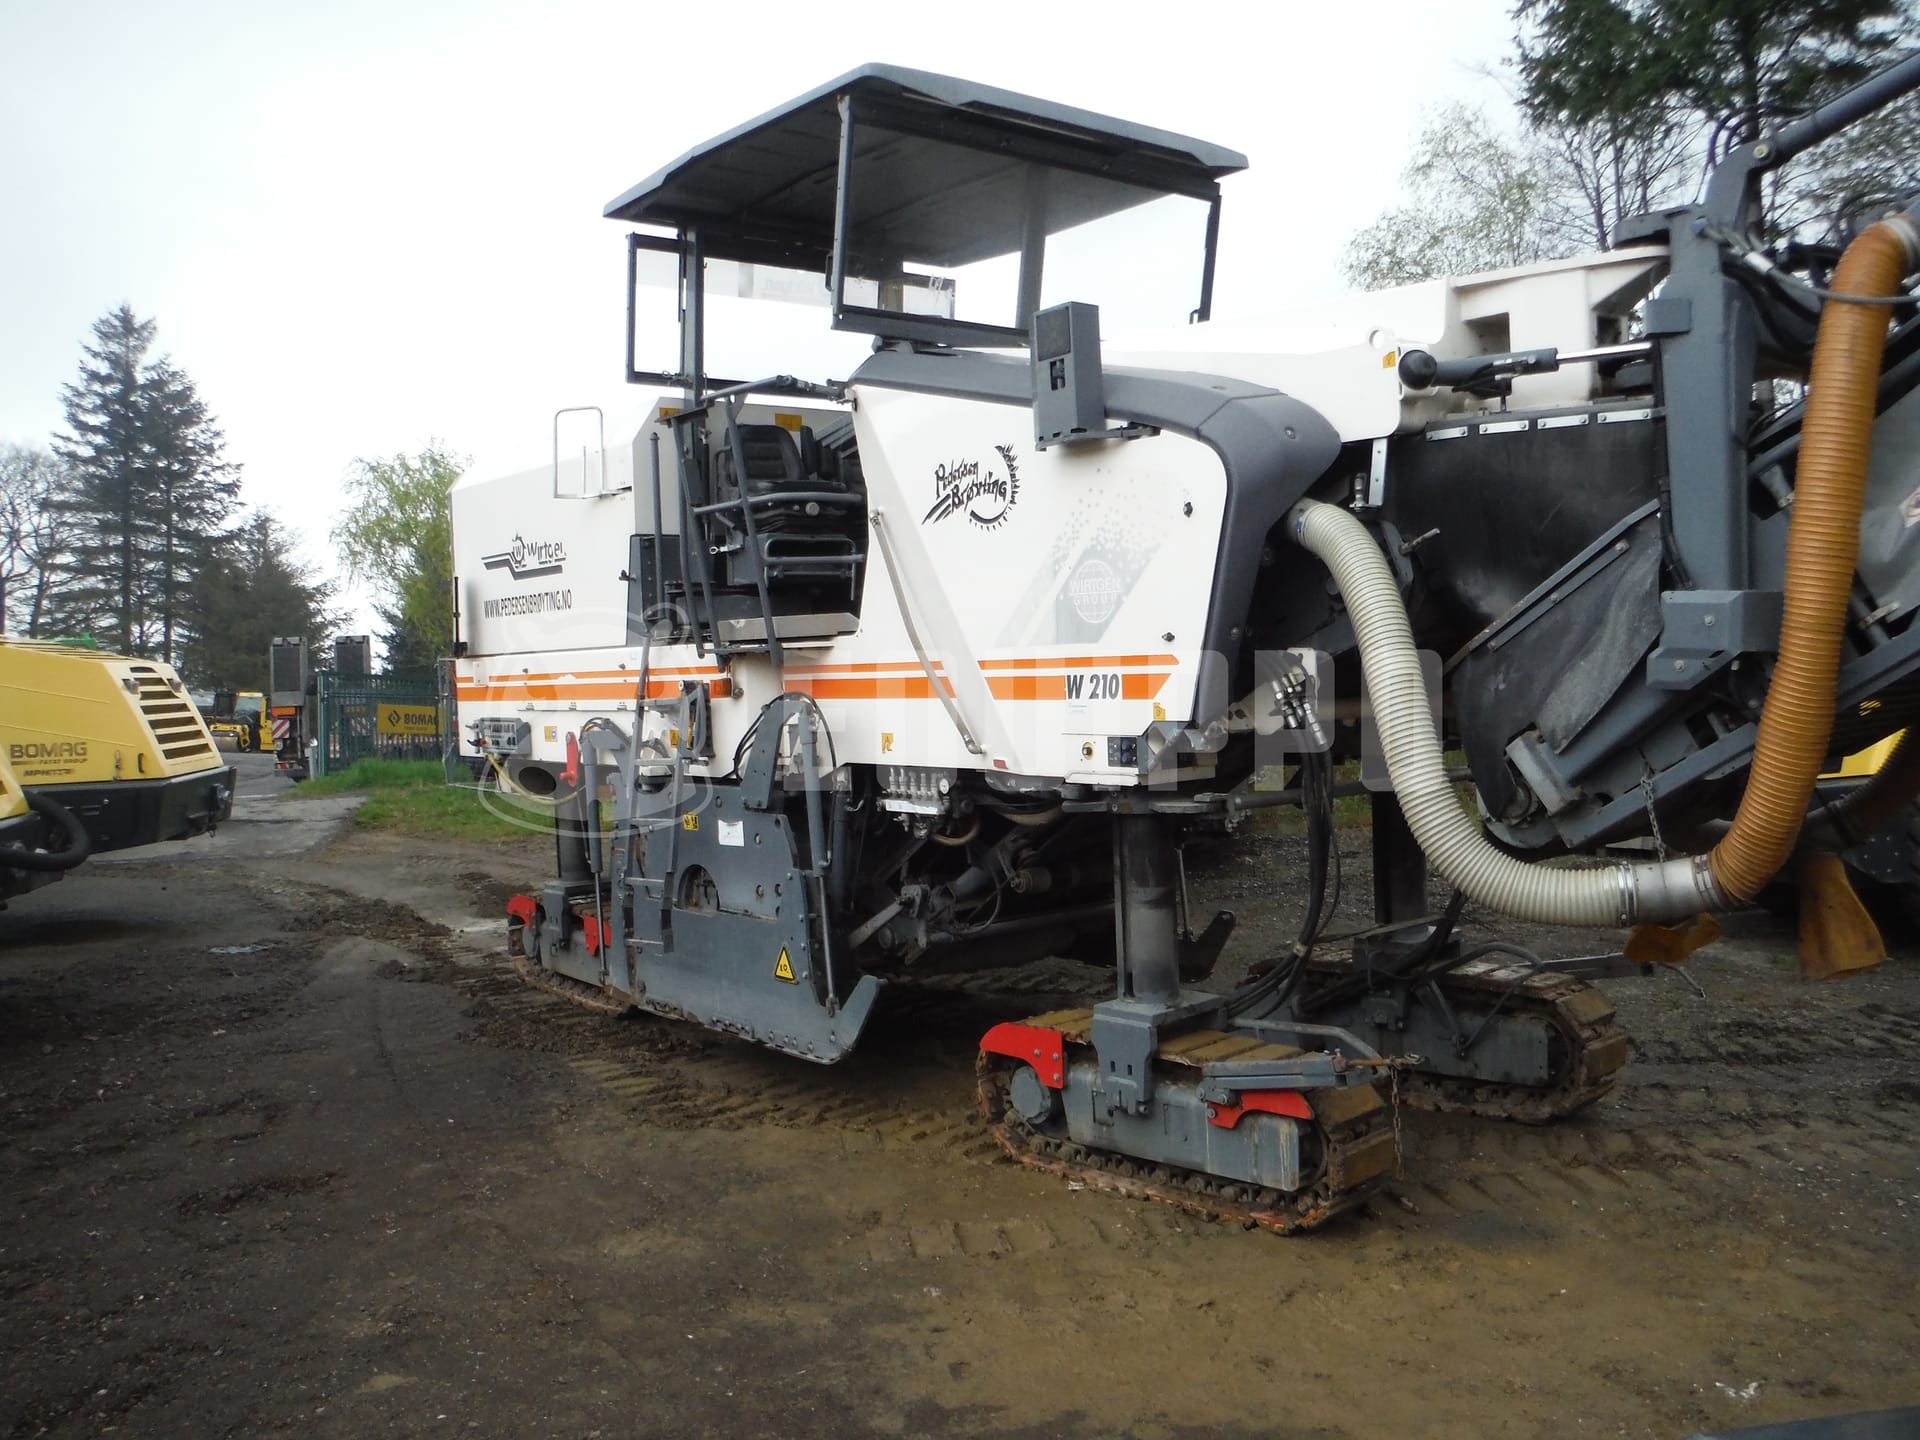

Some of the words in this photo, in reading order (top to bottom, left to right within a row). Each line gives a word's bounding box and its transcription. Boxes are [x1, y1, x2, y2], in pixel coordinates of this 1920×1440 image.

[1070, 577, 1121, 592] WIRTGEN
[1066, 674, 1085, 700] W
[1088, 673, 1120, 700] 210
[404, 713, 437, 726] BOMA
[10, 742, 87, 759] BOMAG
